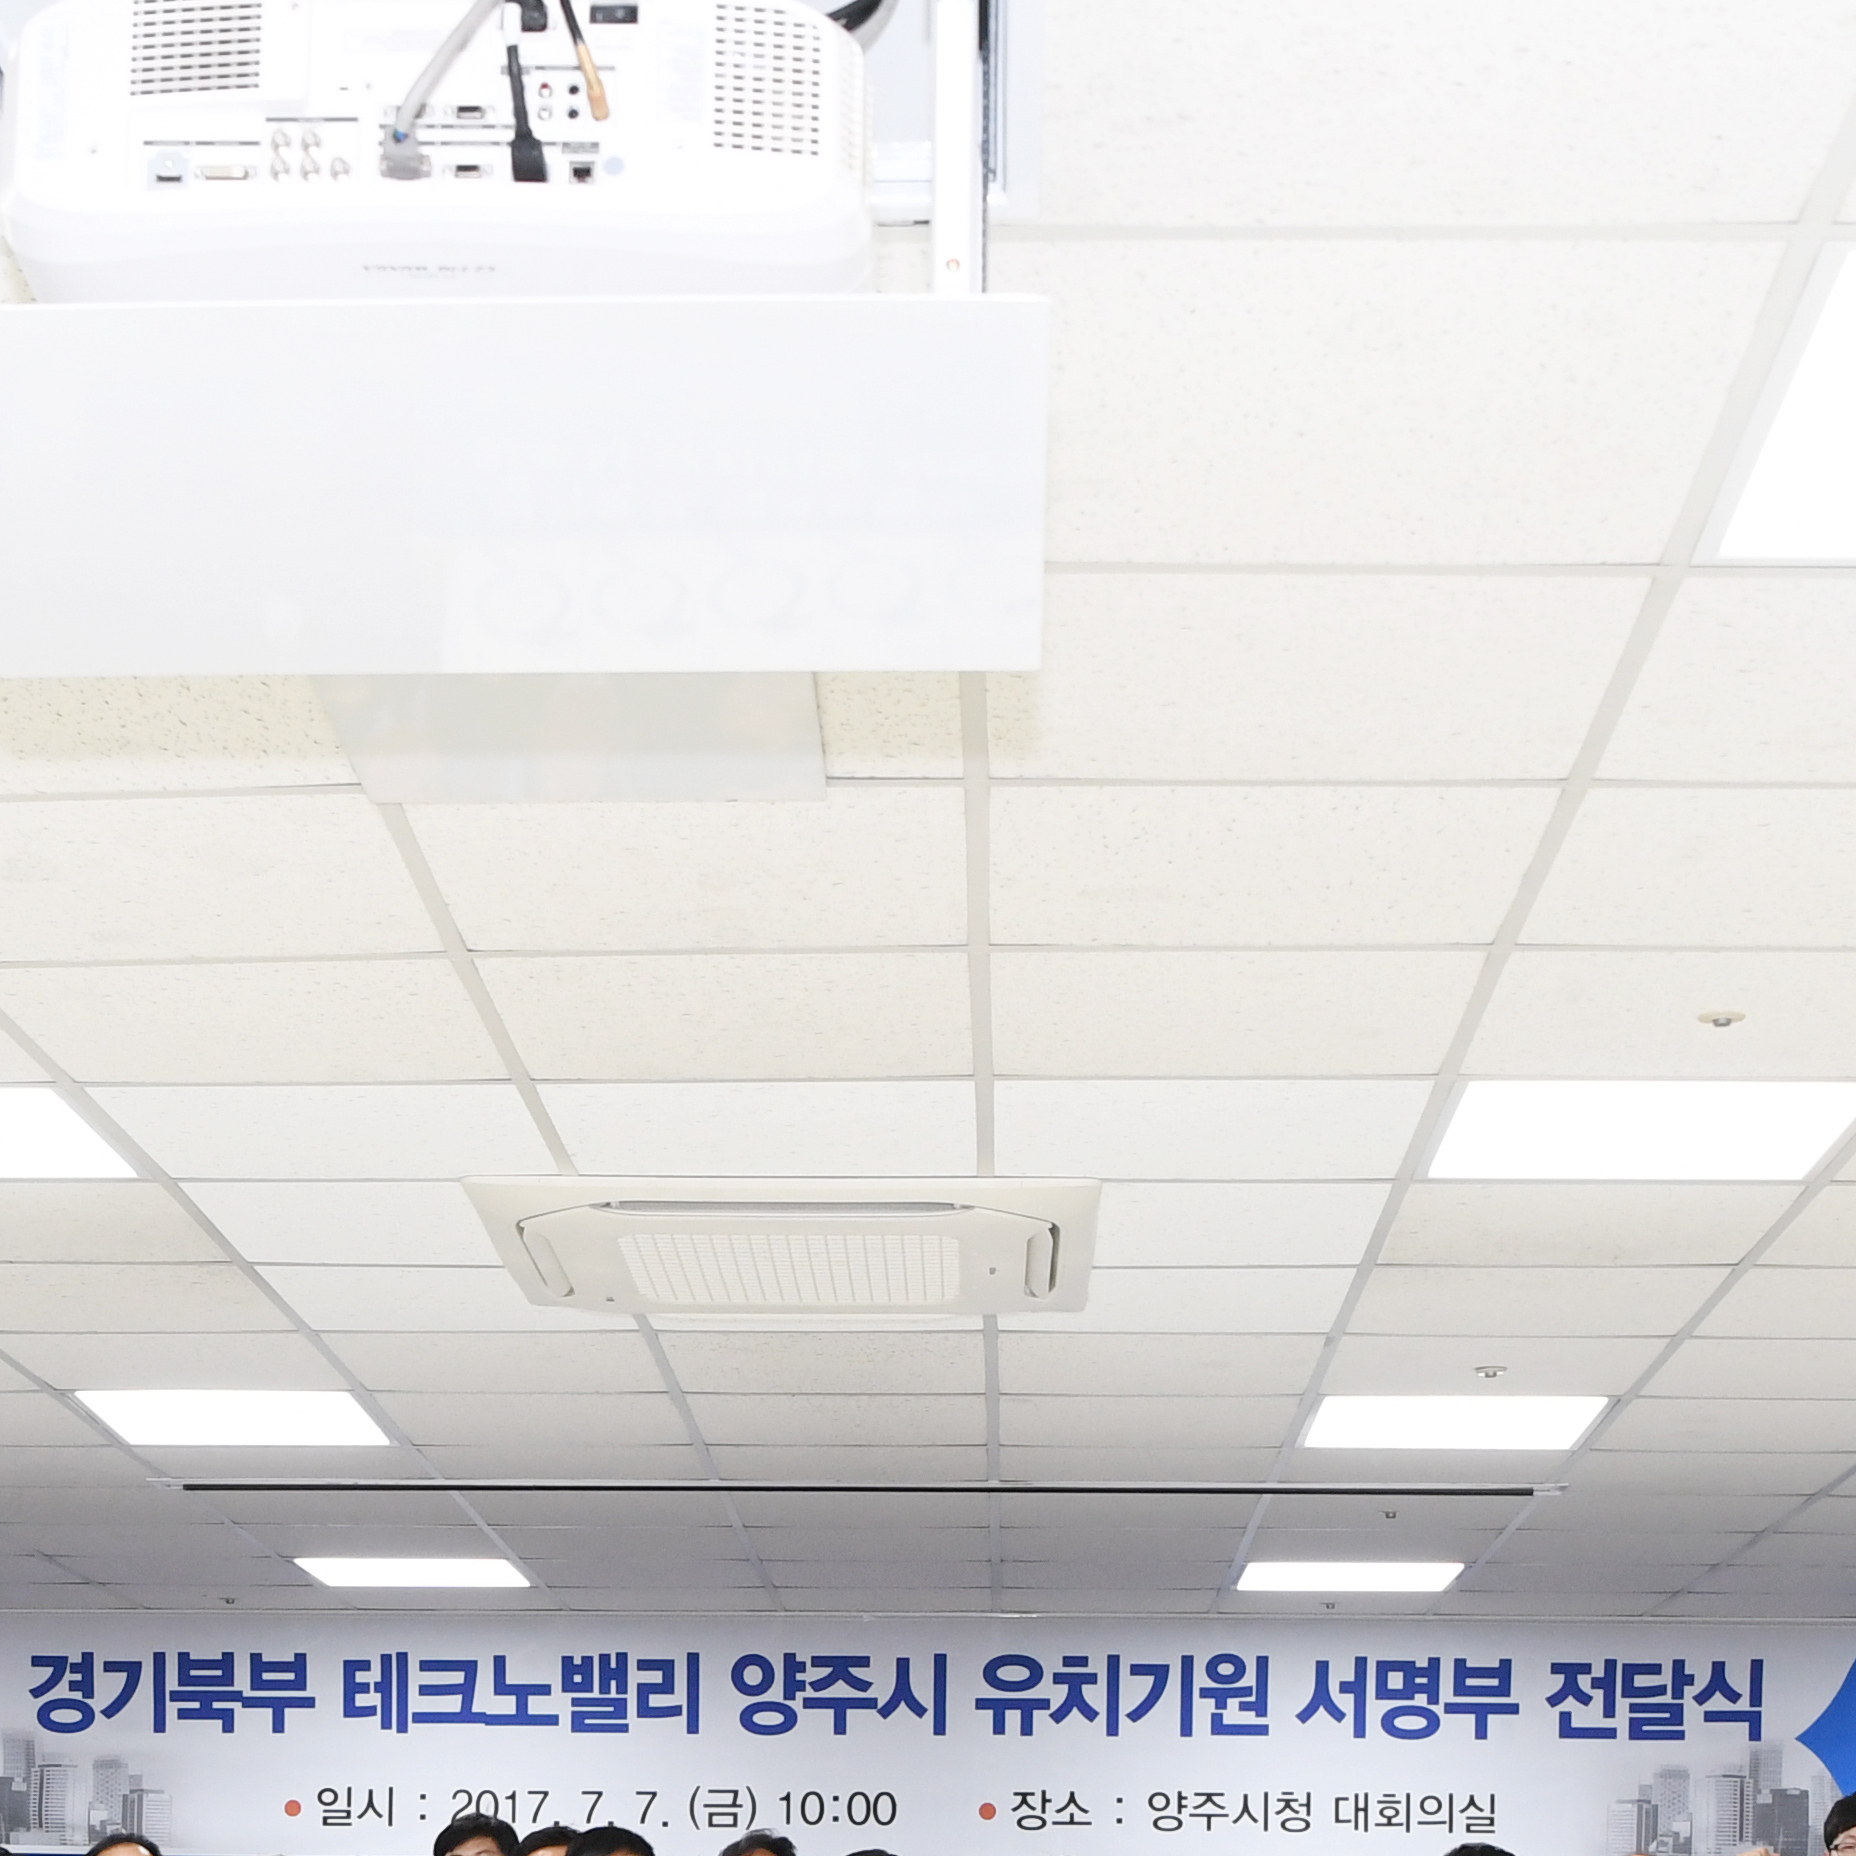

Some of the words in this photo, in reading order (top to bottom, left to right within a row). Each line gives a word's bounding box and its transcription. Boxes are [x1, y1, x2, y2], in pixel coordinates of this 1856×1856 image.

[29, 1652, 316, 1735] 경기북부
[343, 1652, 700, 1735] 테크노밸리
[731, 1653, 948, 1736] 양주시
[975, 1653, 1270, 1738] 유치기원
[1296, 1656, 1520, 1740] 서명부
[1546, 1658, 1765, 1742] 전달식
[317, 1786, 394, 1827] 일시
[635, 1790, 669, 1828] 7.
[689, 1785, 757, 1831] (금)
[778, 1790, 898, 1827] 10:00
[1010, 1789, 1093, 1831] 장소
[1147, 1790, 1312, 1833] 양주시청
[1334, 1792, 1496, 1835] 대회의실
